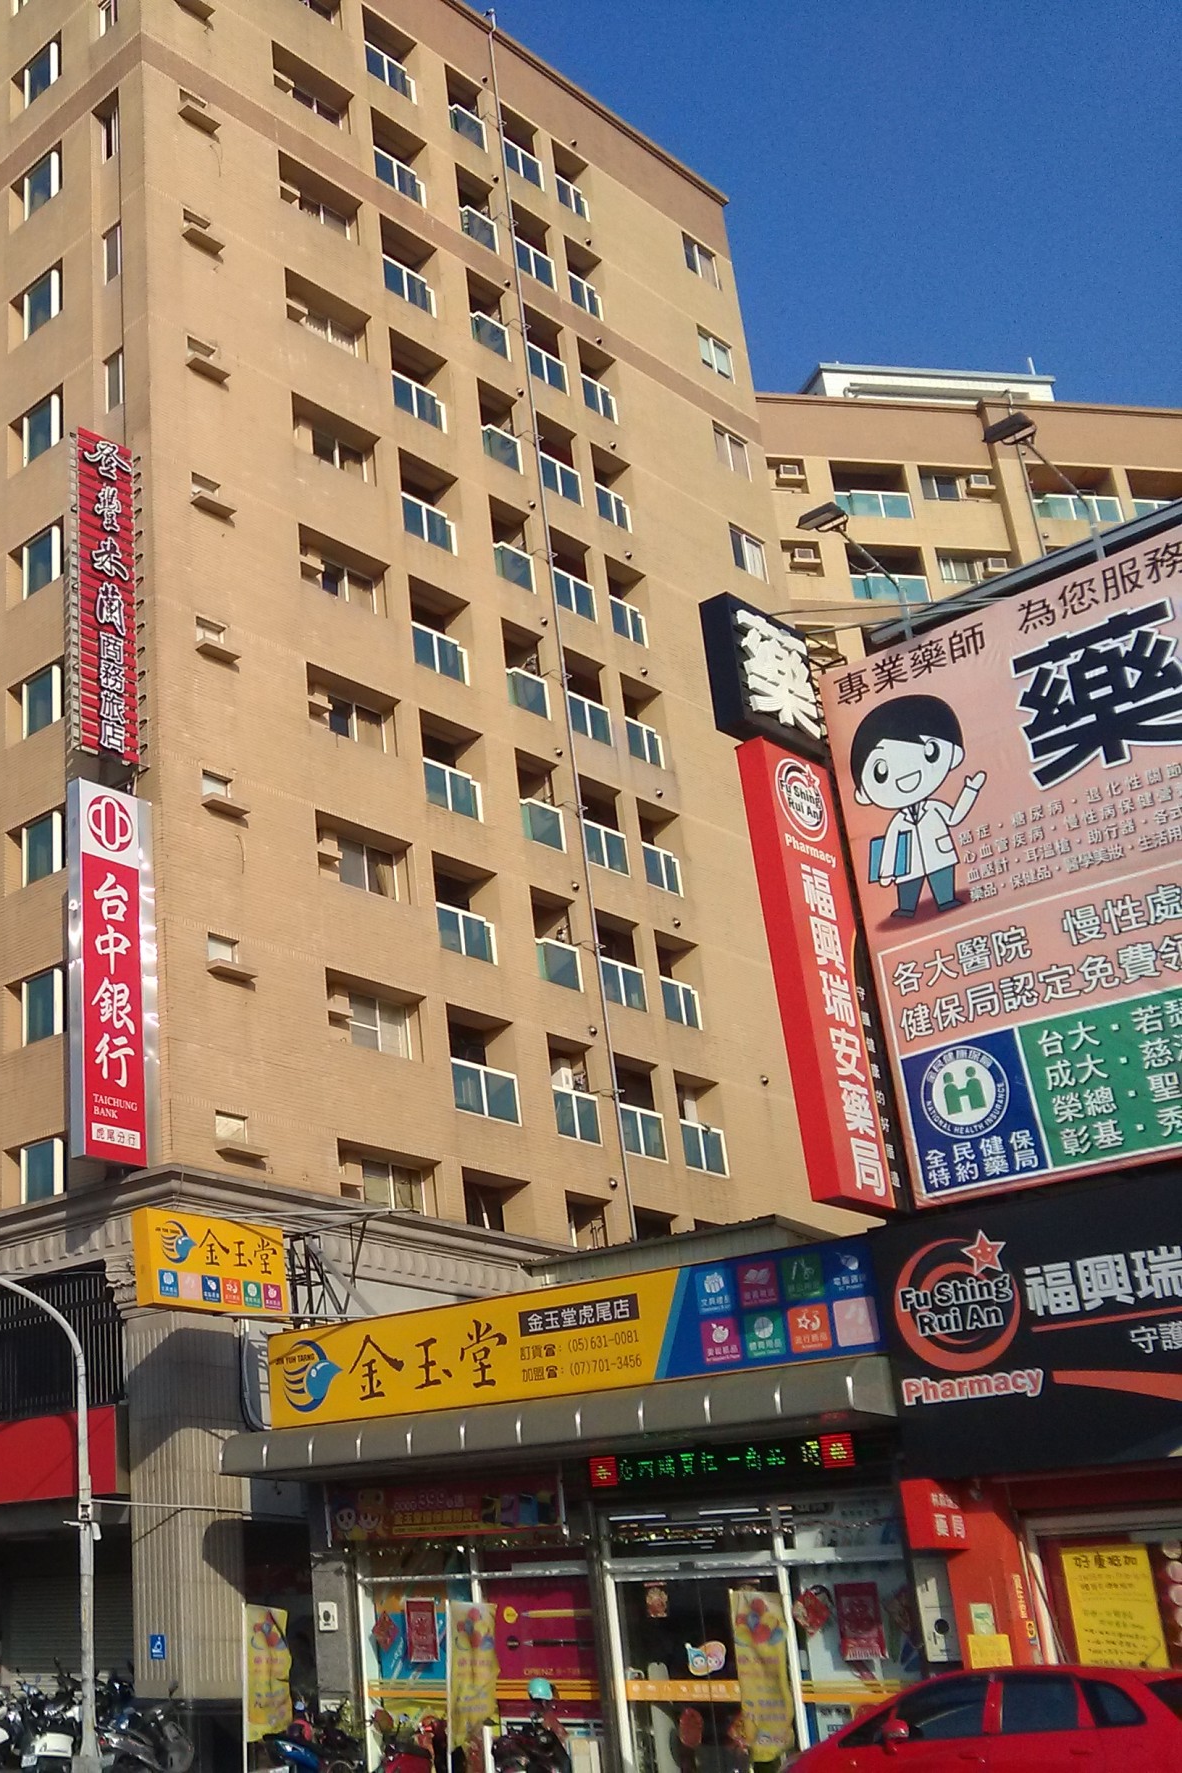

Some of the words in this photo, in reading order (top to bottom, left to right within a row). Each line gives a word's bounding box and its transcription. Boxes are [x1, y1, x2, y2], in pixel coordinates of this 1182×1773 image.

[832, 621, 987, 706] 專業藥師
[1017, 540, 1182, 635] 為您服務
[735, 608, 822, 740] 藥
[1009, 596, 1182, 791] 藥
[779, 779, 792, 796] Fu
[787, 796, 805, 814] Rui
[806, 803, 822, 820] An
[784, 833, 837, 869] Pharmacy
[892, 925, 1032, 997] 各大醫院
[1061, 883, 1182, 947] 慢性處
[91, 871, 136, 1089] 台中銀行
[800, 862, 887, 1198] 福興瑞安藥局
[92, 1092, 138, 1112] TAICHUNG
[93, 1105, 118, 1120] BANK
[926, 1100, 952, 1132] NATIONAL
[953, 1123, 985, 1134] HEALTH
[985, 1082, 1005, 1127] INSURANCE
[96, 1127, 136, 1147] 虎尾分行
[924, 1129, 1036, 1170] 全民健保
[927, 1149, 1039, 1189] 特約藥局
[198, 1228, 278, 1275] 金玉堂
[899, 1287, 931, 1312] Fu
[934, 1273, 1013, 1306] Shing
[1023, 1245, 1182, 1317] 福興瑞
[527, 1299, 631, 1333] 金玉堂虎尾店
[917, 1307, 962, 1336] Rui
[967, 1304, 1004, 1330] An
[567, 1329, 640, 1353] (05)631-0081
[1129, 1321, 1182, 1354] 守護
[348, 1319, 508, 1401] 金玉堂
[569, 1354, 643, 1376] (07)701-3456
[901, 1368, 1044, 1406] Pharmacy
